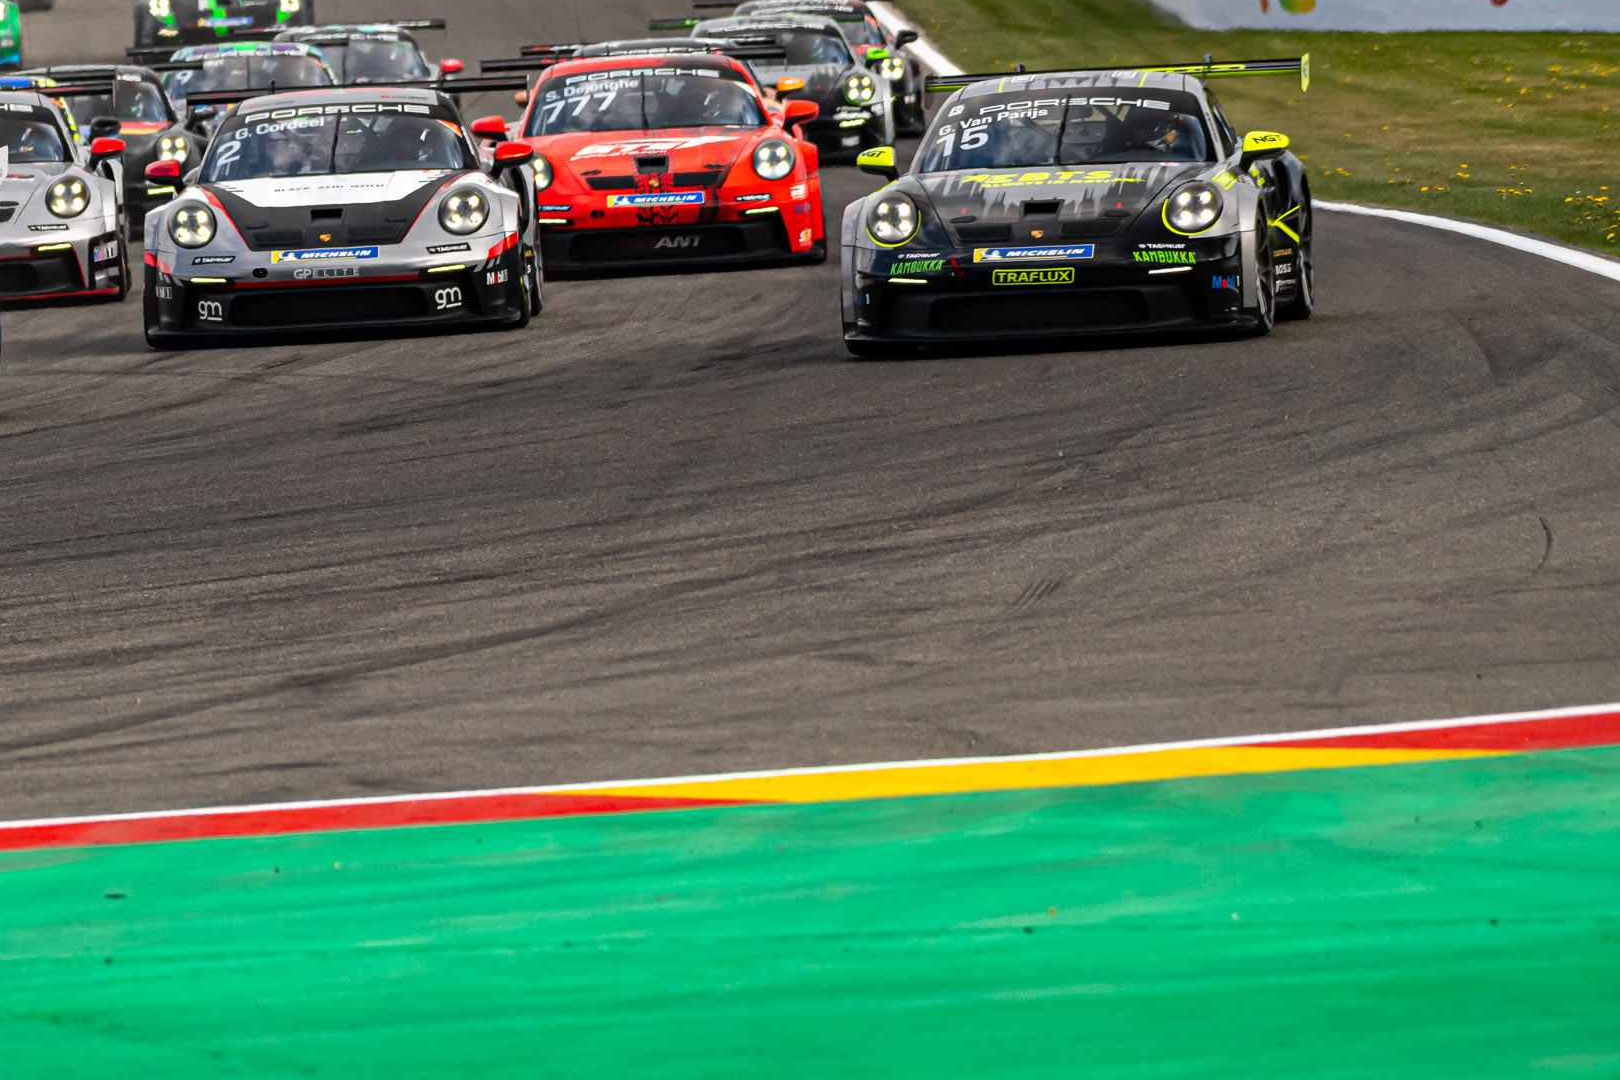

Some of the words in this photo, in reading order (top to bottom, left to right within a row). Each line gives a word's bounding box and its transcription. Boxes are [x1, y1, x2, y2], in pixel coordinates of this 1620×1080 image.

[566, 68, 720, 85] PORSCHE
[545, 90, 561, 102] S.
[563, 79, 640, 98] Dejonghe
[245, 104, 430, 124] PORSCHE
[542, 91, 618, 124] 777
[980, 97, 1171, 115] PORSCHE
[235, 127, 252, 140] G.
[256, 116, 325, 135] Cordeel
[939, 124, 956, 137] G.
[960, 115, 993, 129] Van
[997, 107, 1048, 122] Parijs
[936, 125, 989, 157] 15
[216, 140, 242, 168] 2
[634, 194, 697, 204] MICHELIN
[300, 249, 372, 259] MICHELIN
[1005, 248, 1086, 257] MICHELIN
[1132, 251, 1196, 264] KAMBUKKA
[890, 259, 945, 275] KAMBUKKA
[996, 270, 1072, 283] TRAFLUX
